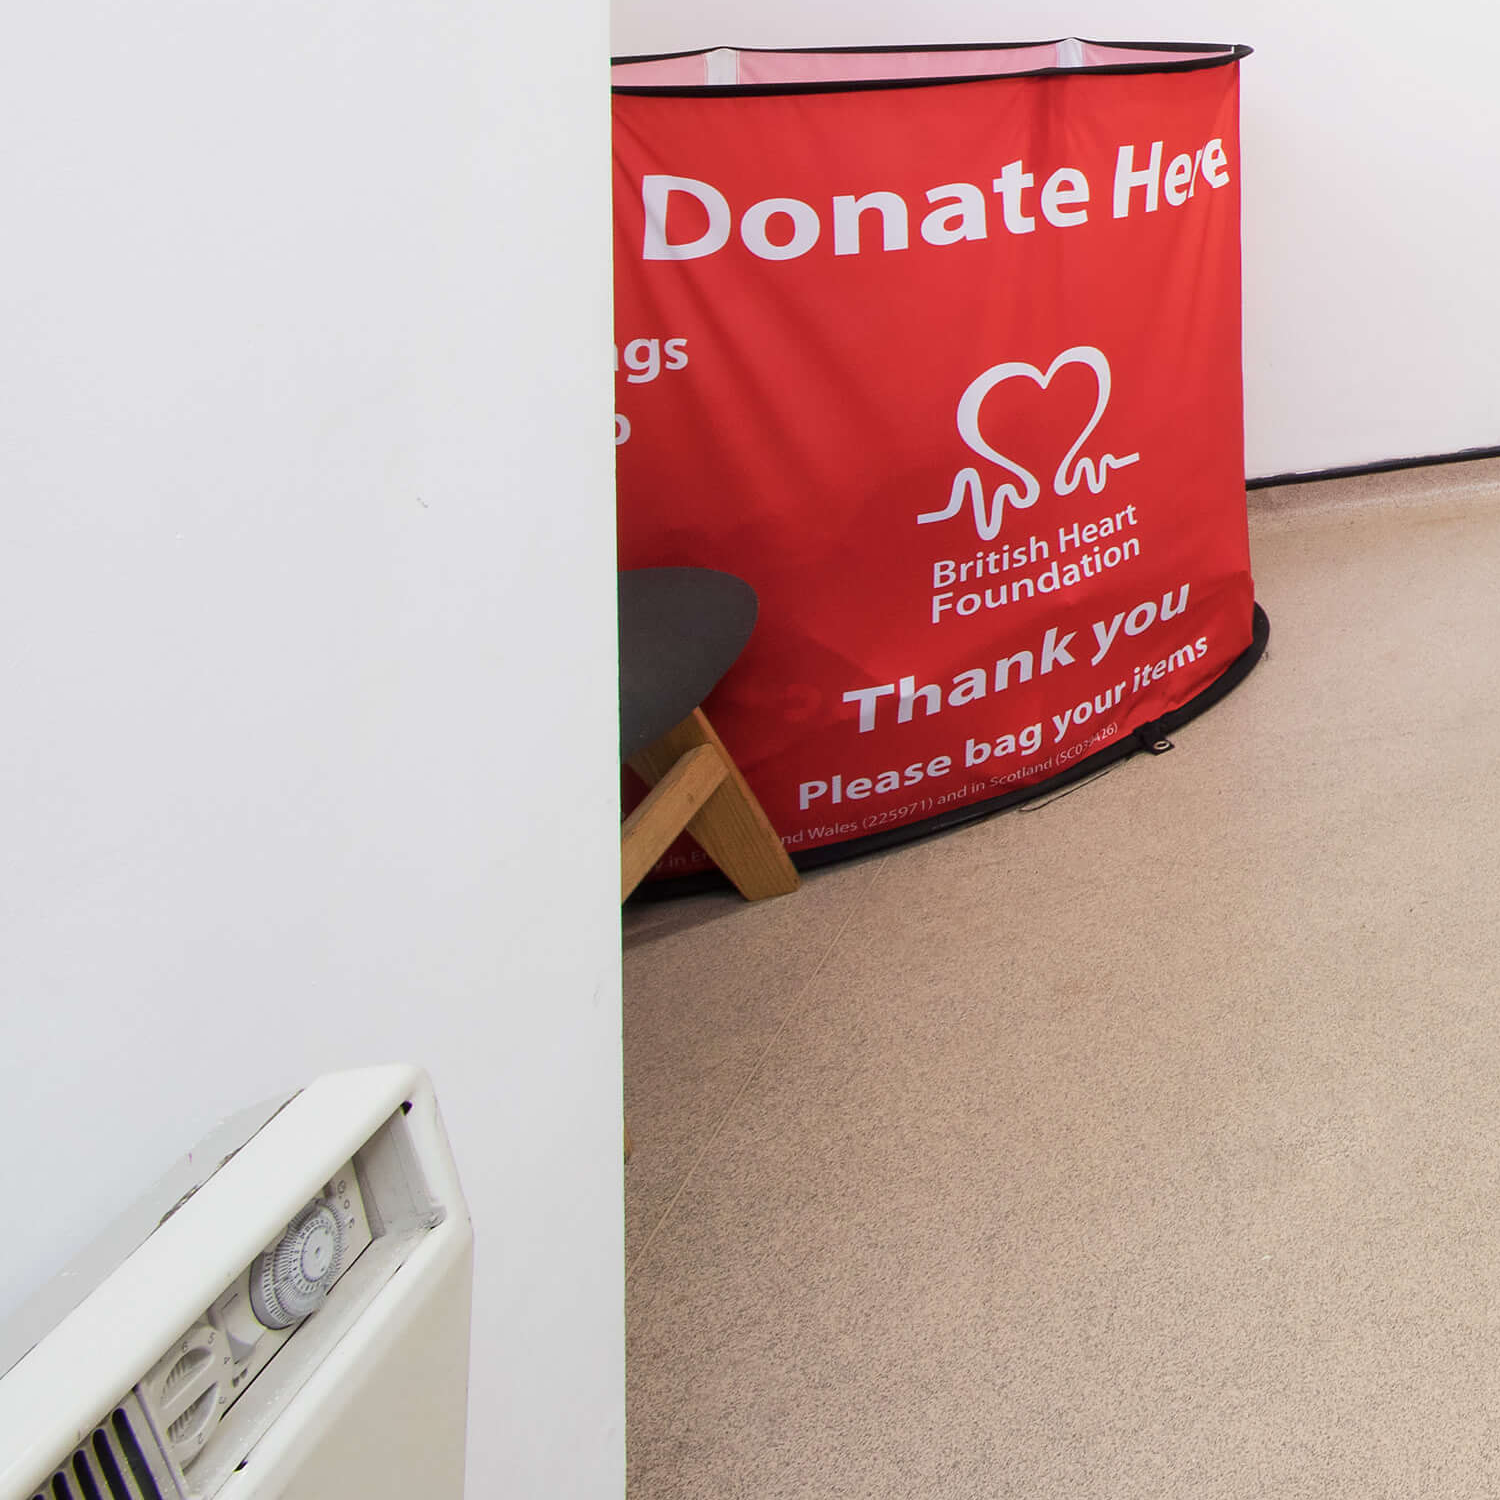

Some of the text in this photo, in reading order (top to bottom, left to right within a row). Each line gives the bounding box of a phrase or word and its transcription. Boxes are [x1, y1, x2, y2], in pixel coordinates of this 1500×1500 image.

[642, 137, 1230, 261] Donate Here
[931, 534, 1140, 624] Foundation
[932, 503, 1138, 589] British Heart
[842, 582, 1191, 733] Thank you
[800, 634, 1209, 810] Please bag your items
[808, 758, 1052, 841] Wales (225971) and in Scotland
